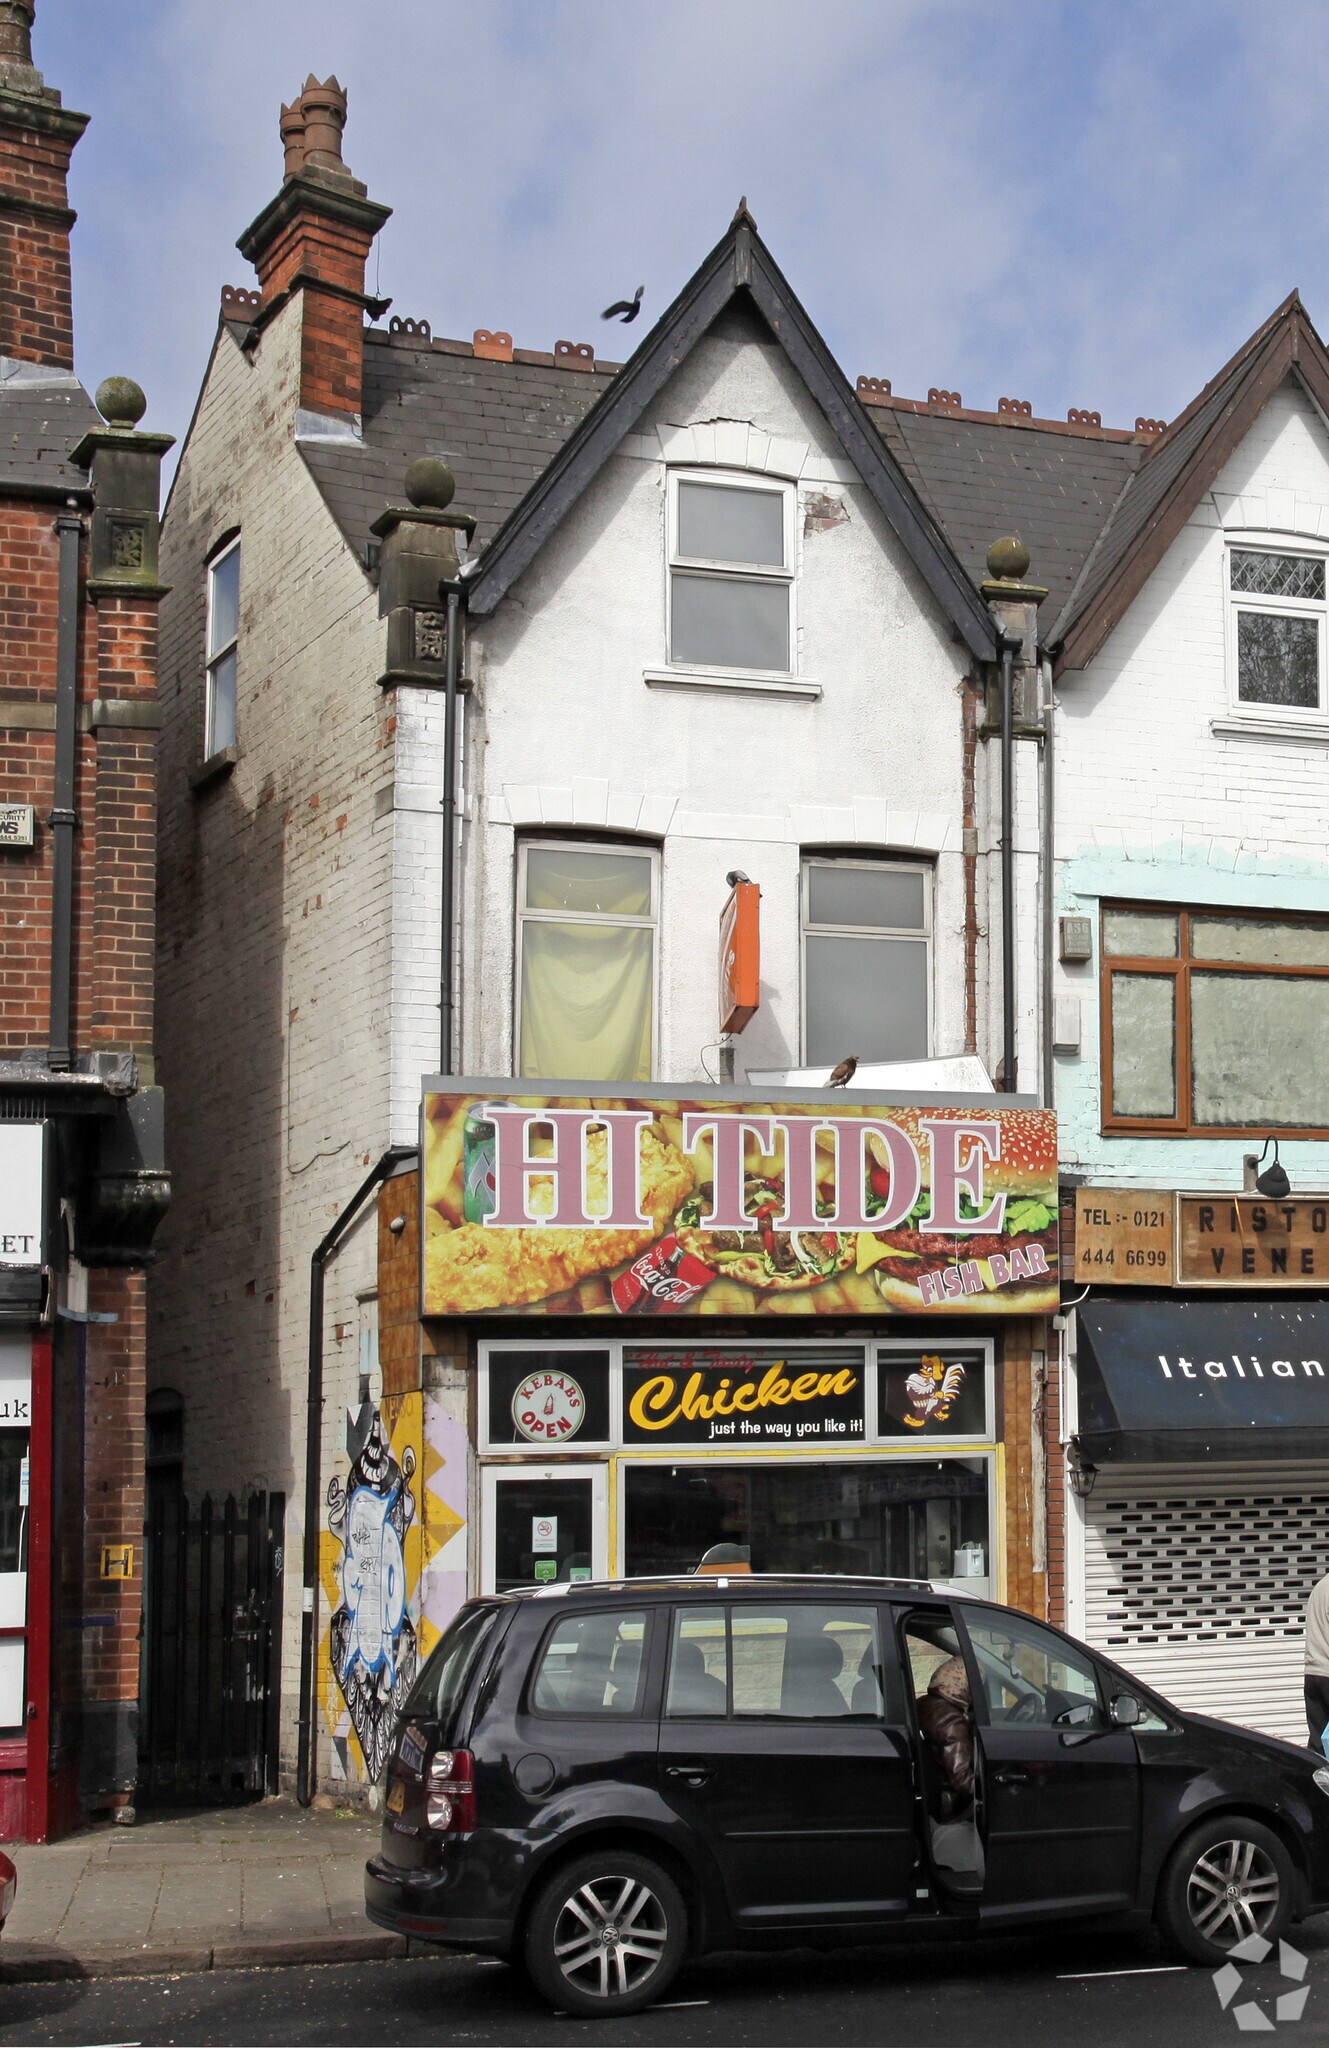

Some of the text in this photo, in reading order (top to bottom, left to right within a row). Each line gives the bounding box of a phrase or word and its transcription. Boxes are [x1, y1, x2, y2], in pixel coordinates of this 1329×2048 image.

[482, 1106, 1008, 1234] HI TIDE
[1133, 1210, 1165, 1228] 0121
[1199, 1206, 1327, 1233] RISTO
[1082, 1248, 1166, 1267] 444 6699
[1211, 1248, 1315, 1275] VENE
[917, 1243, 1050, 1307] FISH BAR
[1158, 1355, 1326, 1379] Italian
[521, 1374, 580, 1408] KEBABS
[629, 1360, 858, 1431] Chicken
[521, 1411, 572, 1438] OPEN
[708, 1418, 863, 1439] just the way you like it!
[104, 1548, 129, 1577] H
